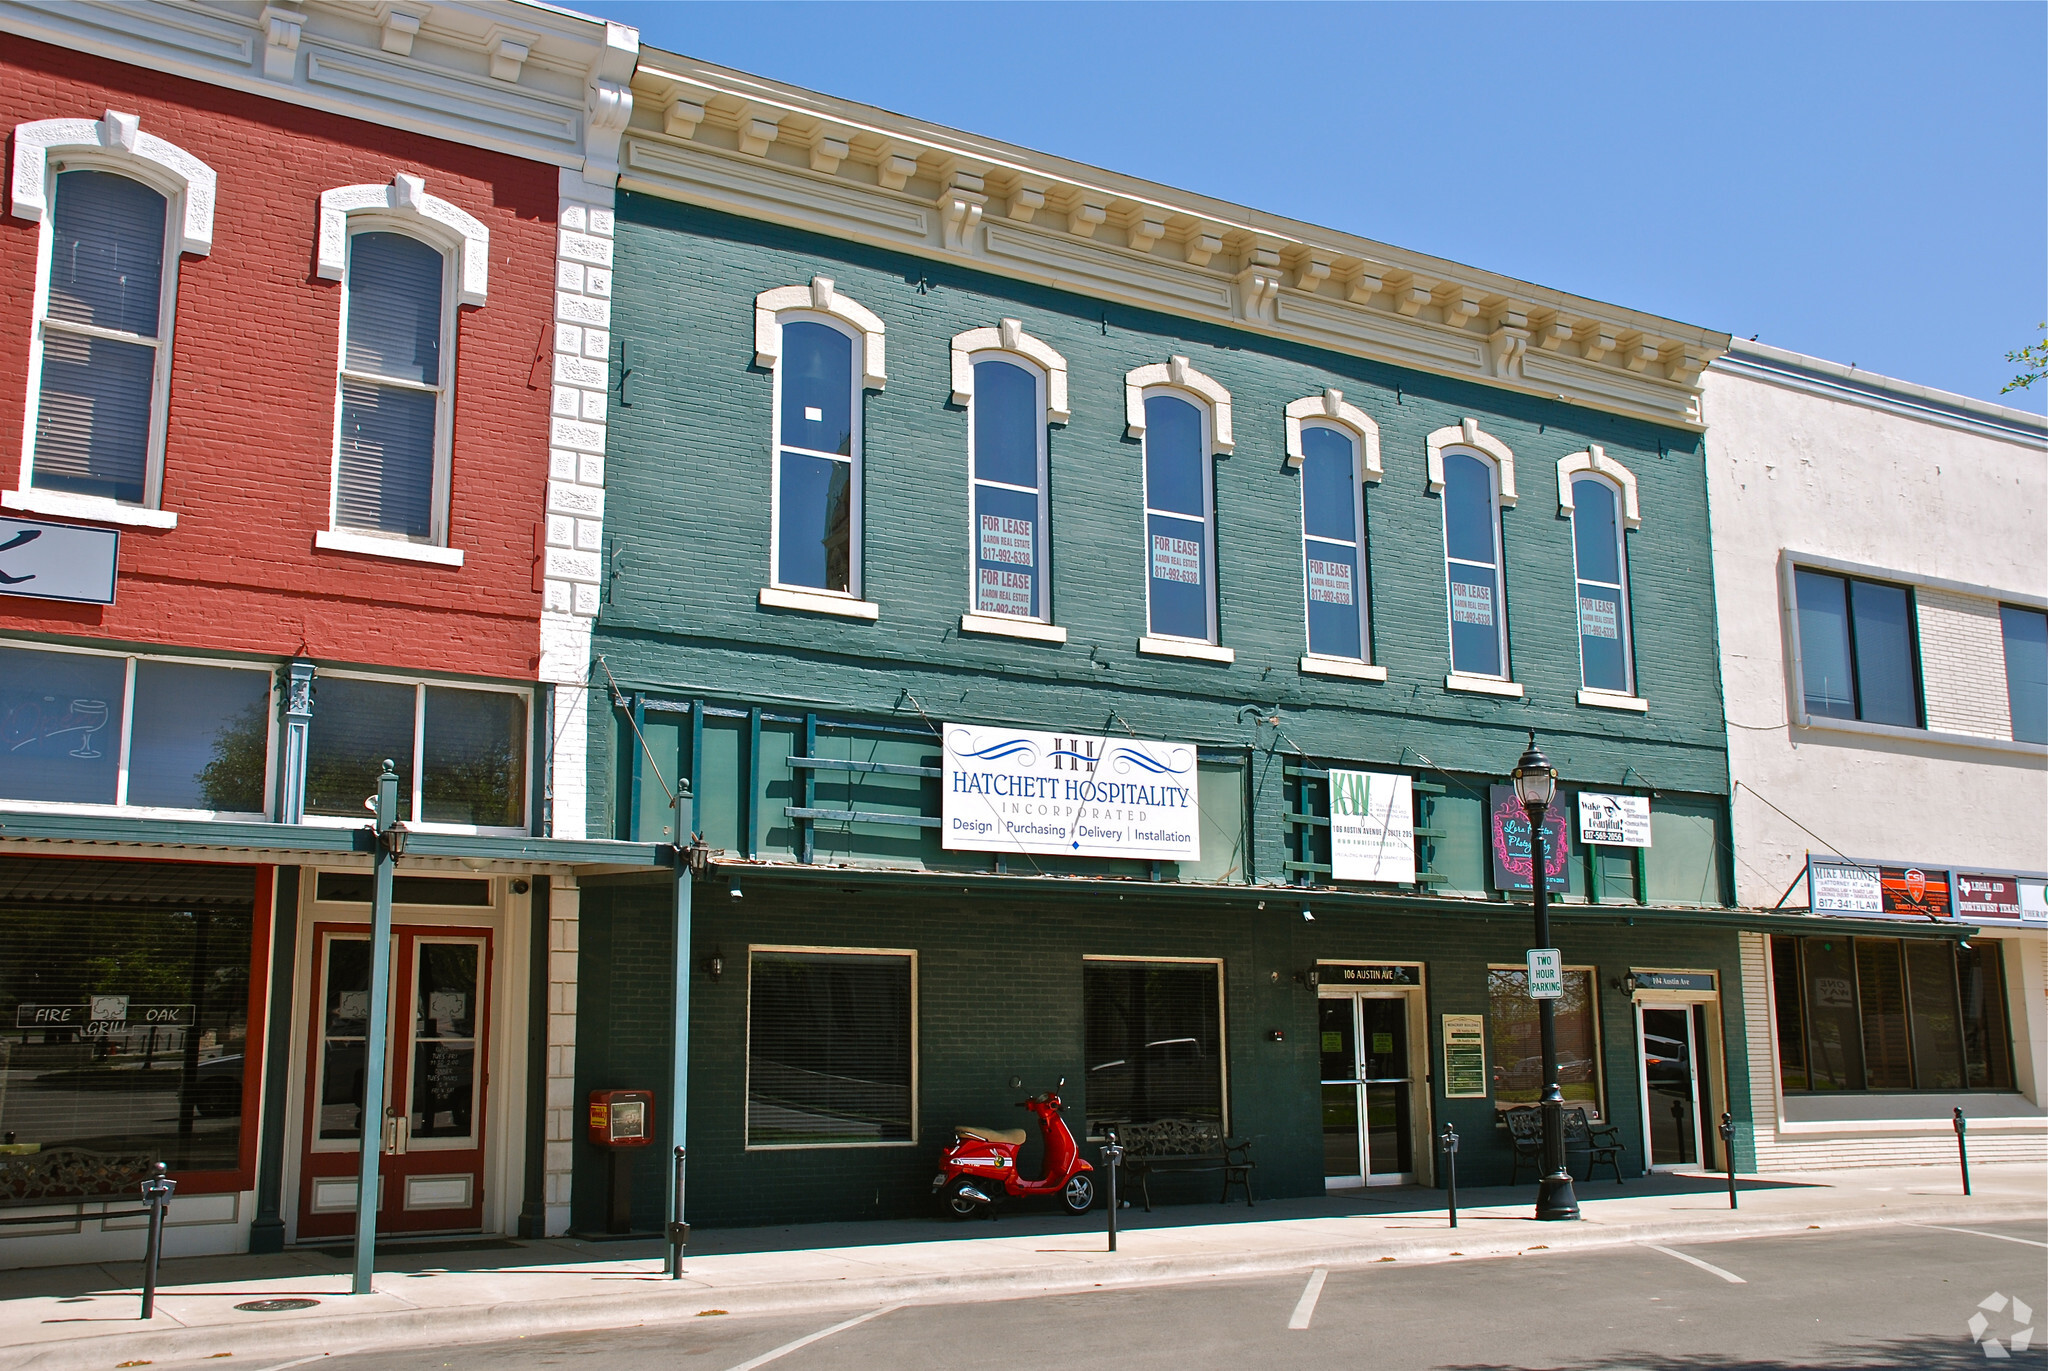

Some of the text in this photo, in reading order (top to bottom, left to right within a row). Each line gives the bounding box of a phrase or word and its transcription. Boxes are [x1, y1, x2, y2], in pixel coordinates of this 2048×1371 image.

[982, 516, 1030, 536] FOR LEASE
[983, 534, 1030, 550] AARON REAL ESTATE
[1154, 536, 1197, 556] FOR LEASE
[983, 547, 1030, 564] 817-992-6338
[1171, 556, 1182, 566] REAL
[1183, 558, 1197, 568] ESTATE
[1155, 566, 1197, 584] 817-992-6338
[1310, 561, 1349, 578] FOR LEASE
[982, 570, 1030, 590] FOR LEASE
[1325, 579, 1335, 588] REAL
[1336, 581, 1349, 590] ESTATE
[982, 588, 1029, 603] AARON REAL ESTATE
[1453, 584, 1489, 600] FOR LEASE
[1582, 599, 1613, 614] FOR LEASE
[953, 771, 1190, 808] HATCHETT HOSPITALITY
[1332, 772, 1371, 816] KW
[1002, 802, 1147, 822] INCORPORATED
[1582, 801, 1600, 810] Wake
[953, 818, 1191, 842] Design Purchasing Delivery Installation
[1344, 826, 1362, 834] AUSTIN
[1363, 828, 1382, 836] AVENUE
[1815, 867, 1878, 883] MIKE MALONEY
[1907, 874, 1923, 882] CSI
[1971, 881, 2004, 892] LEGAL AID
[1819, 898, 1878, 909] 817-341-1LAW
[1960, 902, 2020, 914] NORTHWEST TEXAS
[1537, 956, 1551, 965] TWO
[1344, 969, 1393, 980] 106 AUSTIN AVE
[1536, 969, 1554, 978] HOUR
[1532, 982, 1560, 992] PARKING
[35, 1009, 71, 1022] FIRE
[146, 1009, 179, 1021] OAK
[87, 1020, 127, 1036] GRILL
